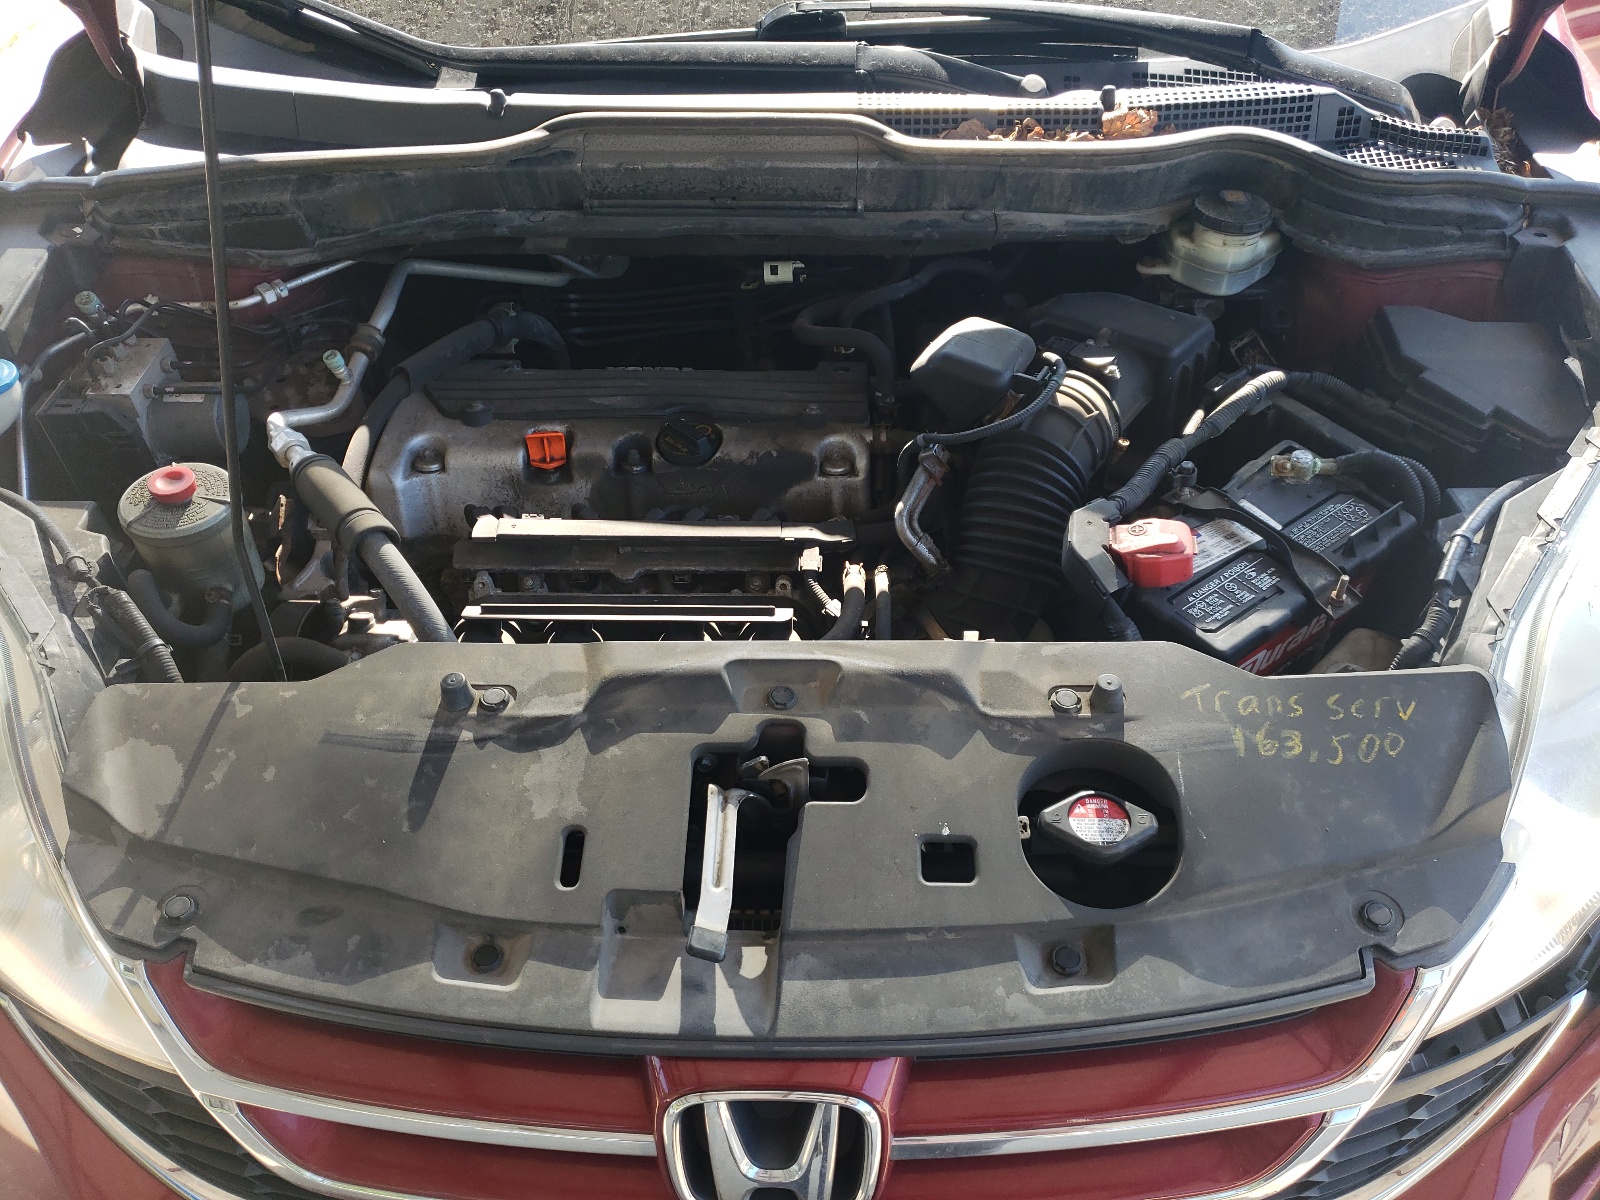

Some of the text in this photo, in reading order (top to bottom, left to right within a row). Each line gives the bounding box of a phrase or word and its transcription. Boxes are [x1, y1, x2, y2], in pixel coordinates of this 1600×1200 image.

[1192, 578, 1222, 599] DANGER
[1222, 560, 1250, 579] POISON
[1240, 613, 1328, 674] Durala
[1179, 683, 1304, 718] Trans
[1230, 721, 1406, 766] 163,500
